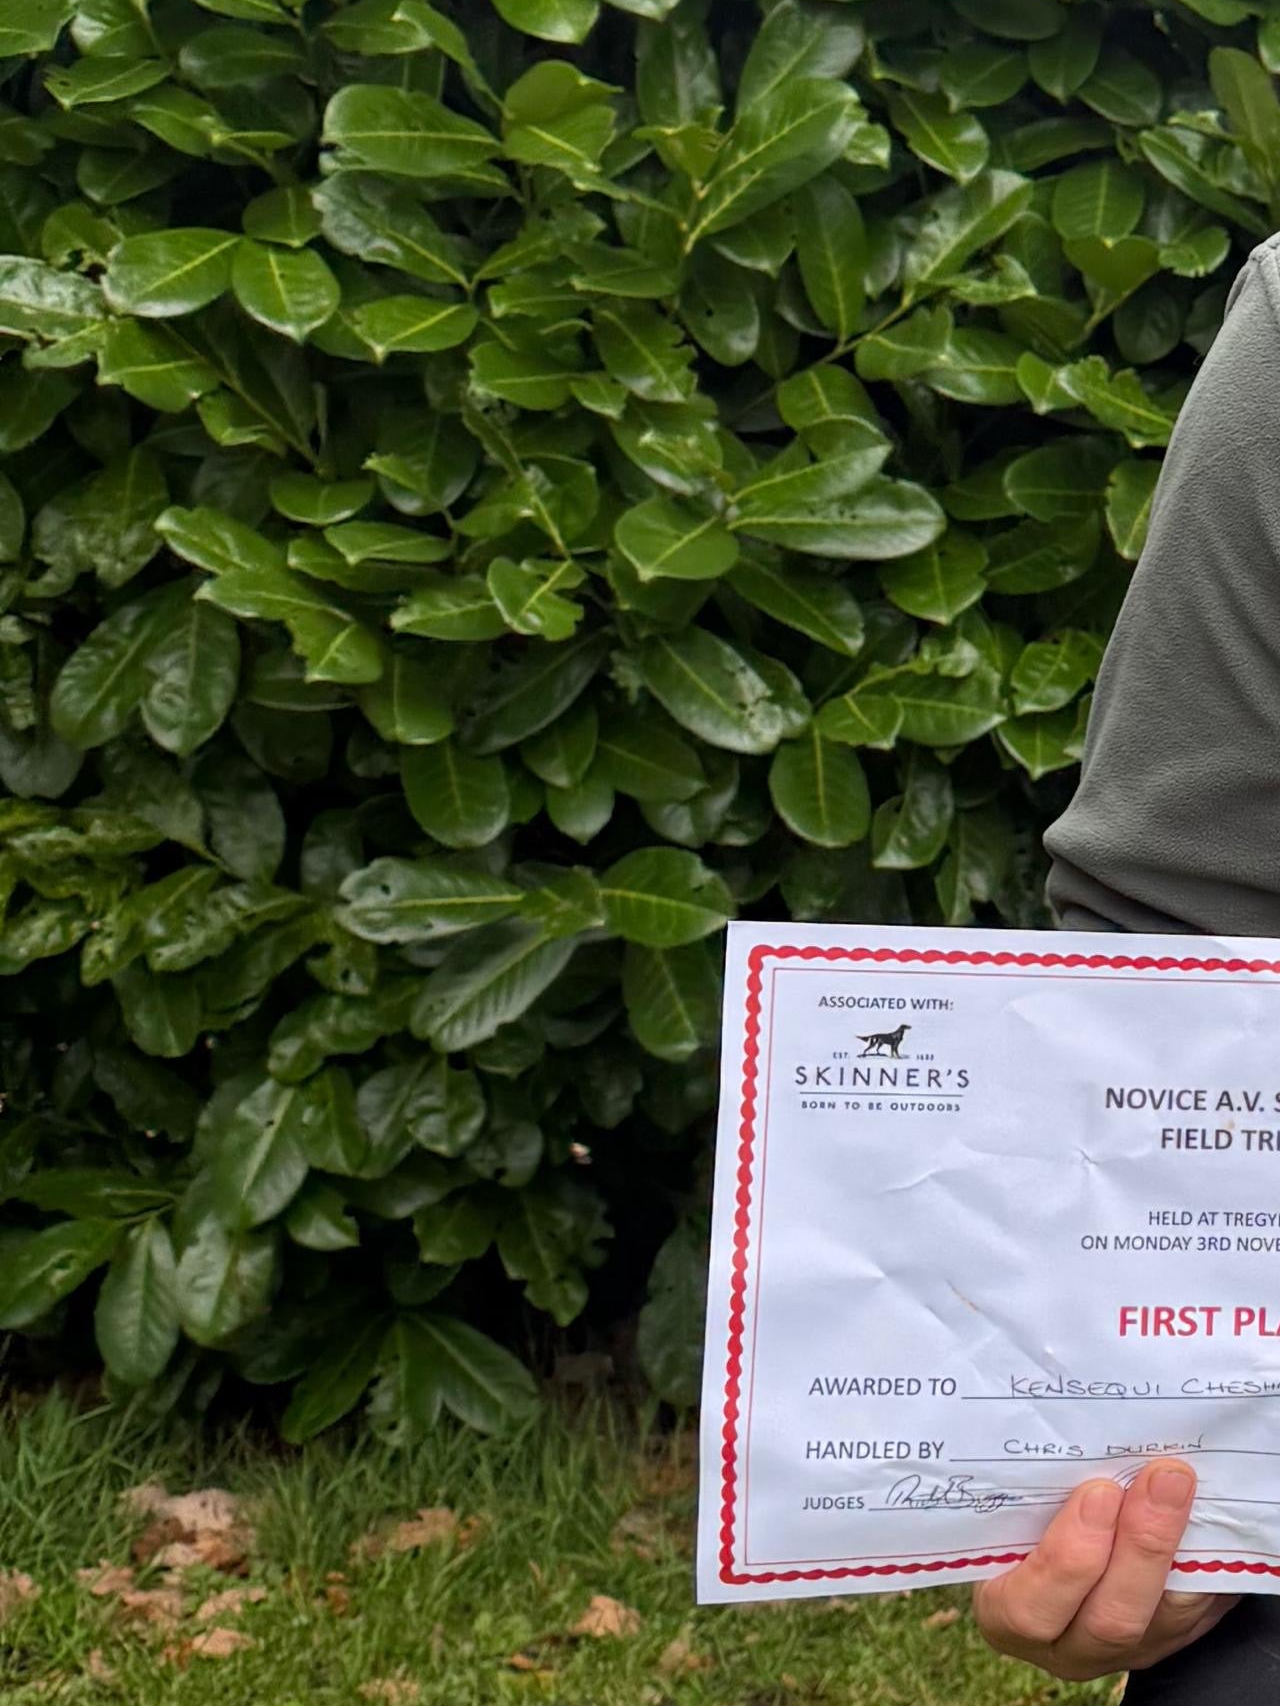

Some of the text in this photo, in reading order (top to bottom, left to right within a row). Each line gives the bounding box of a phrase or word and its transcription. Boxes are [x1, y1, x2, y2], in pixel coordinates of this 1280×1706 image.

[818, 996, 955, 1011] ASSOCIATED WITH:
[795, 1065, 970, 1089] SKINNER'S
[801, 1101, 961, 1112] BORN TO BE OUTDOORS
[1105, 1087, 1208, 1112] NOVICE
[1215, 1090, 1265, 1112] A.V.
[1160, 1127, 1233, 1150] FIELD
[1148, 1210, 1193, 1227] HELD
[1197, 1211, 1220, 1226] AT
[1081, 1235, 1108, 1250] ON
[1113, 1235, 1193, 1251] MONDAY
[1196, 1236, 1232, 1252] 3RD
[1118, 1306, 1223, 1338] FIRST
[808, 1376, 958, 1397] AWARDED TO
[806, 1440, 945, 1461] HANDLED BY
[1003, 1432, 1204, 1457] CHRIS DURKIN
[802, 1495, 866, 1511] JUDGES
